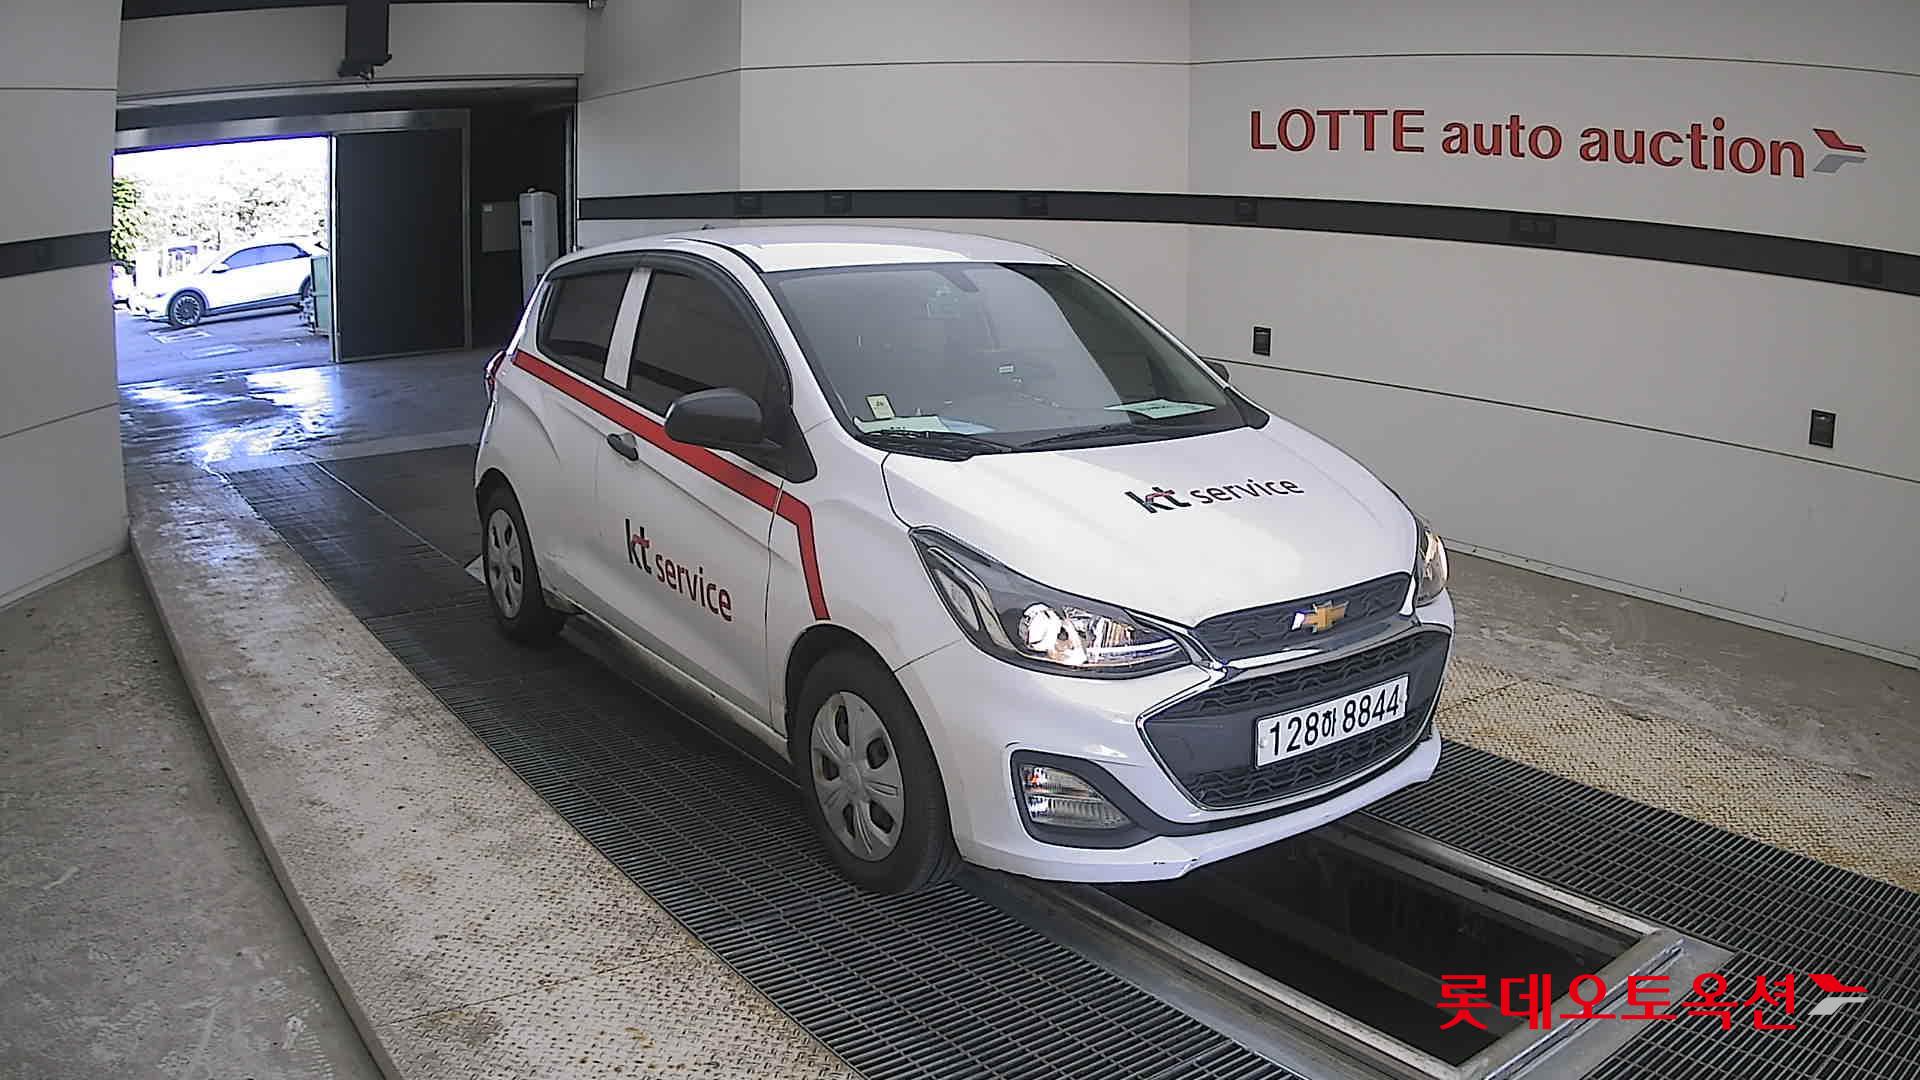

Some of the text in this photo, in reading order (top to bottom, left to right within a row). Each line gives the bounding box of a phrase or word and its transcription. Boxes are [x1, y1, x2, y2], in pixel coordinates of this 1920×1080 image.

[1250, 108, 1805, 178] LOTTE auto auction
[1124, 478, 1304, 514] kt service
[625, 518, 732, 622] kt service
[1269, 684, 1400, 756] 128하 8844
